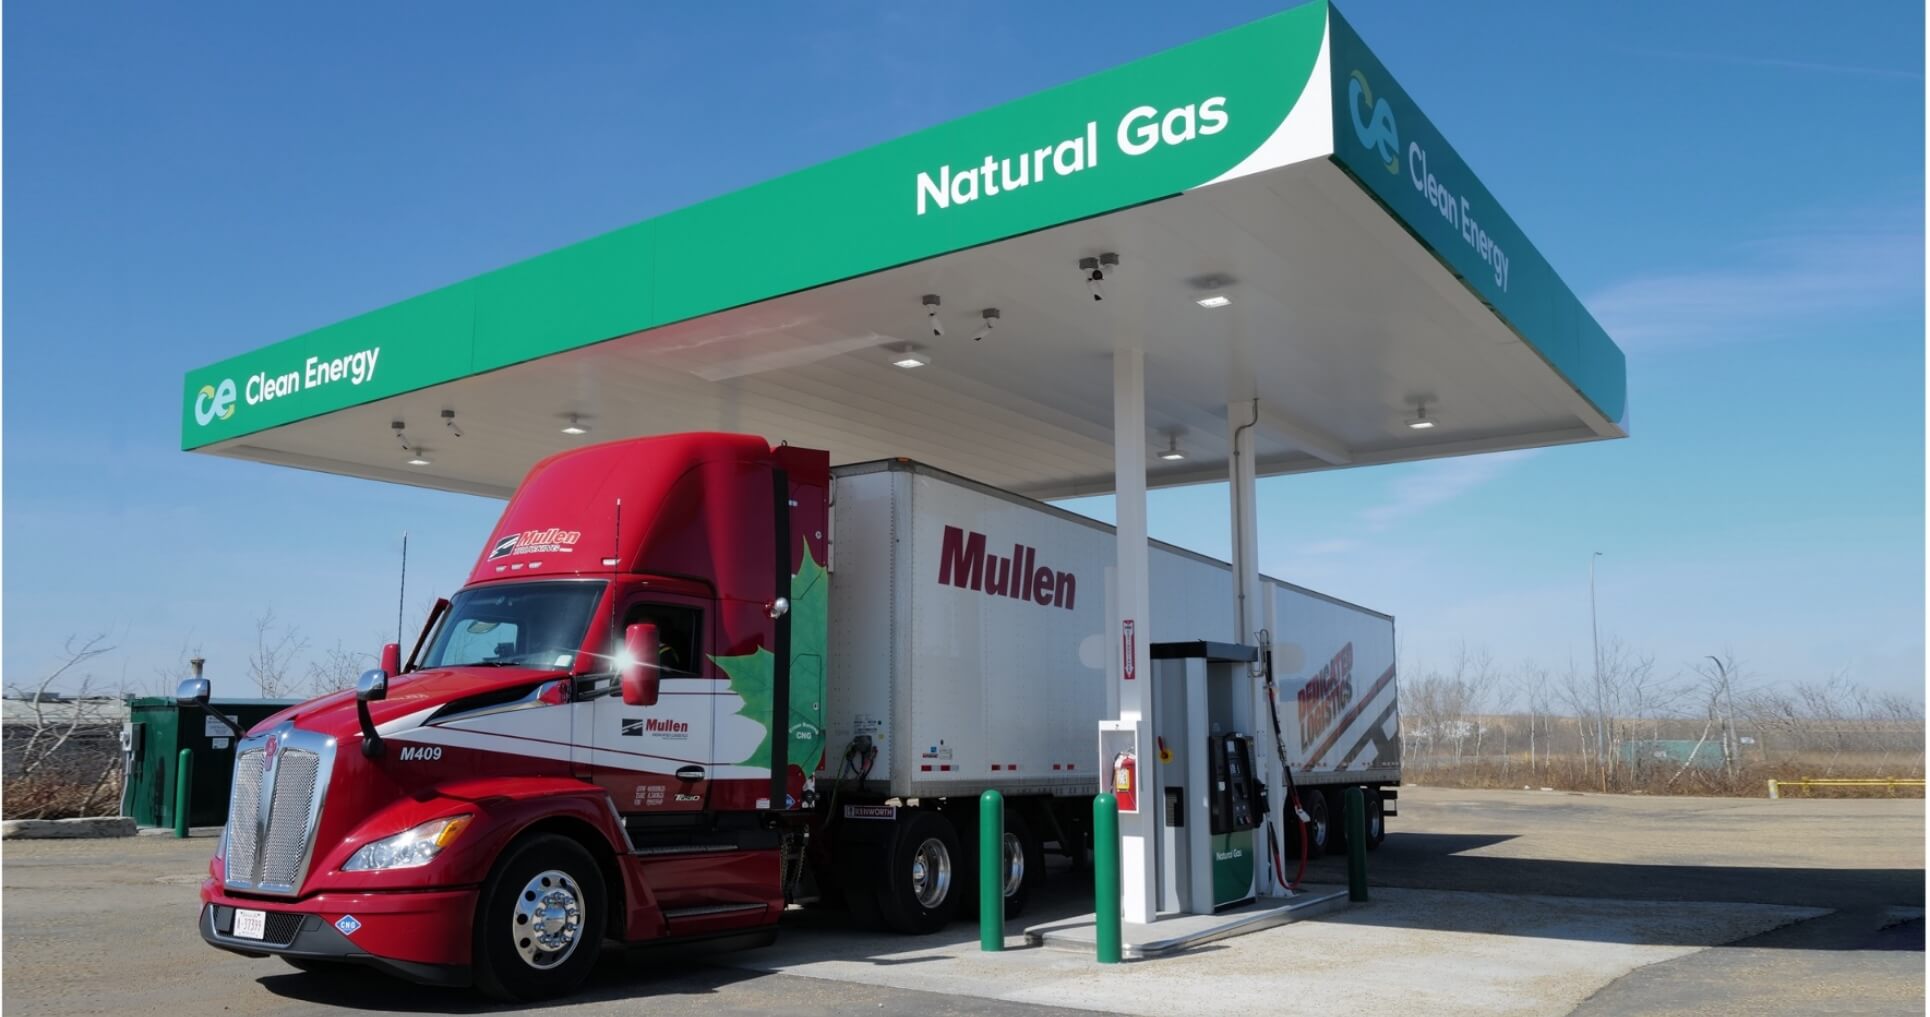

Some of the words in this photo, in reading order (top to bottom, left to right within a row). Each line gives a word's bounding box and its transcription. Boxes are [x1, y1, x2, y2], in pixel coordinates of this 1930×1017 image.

[916, 121, 1097, 215] Natural
[1116, 96, 1229, 155] Gas
[1408, 141, 1459, 230] Clean
[1461, 195, 1510, 293] Energy
[245, 371, 299, 405] Clean
[304, 347, 380, 389] Energy
[517, 528, 581, 547] Mullen
[938, 524, 1076, 610] Mullen
[646, 718, 688, 732] Mullen
[796, 731, 812, 740] CNG
[400, 746, 442, 761] M409
[340, 920, 356, 929] CNG
